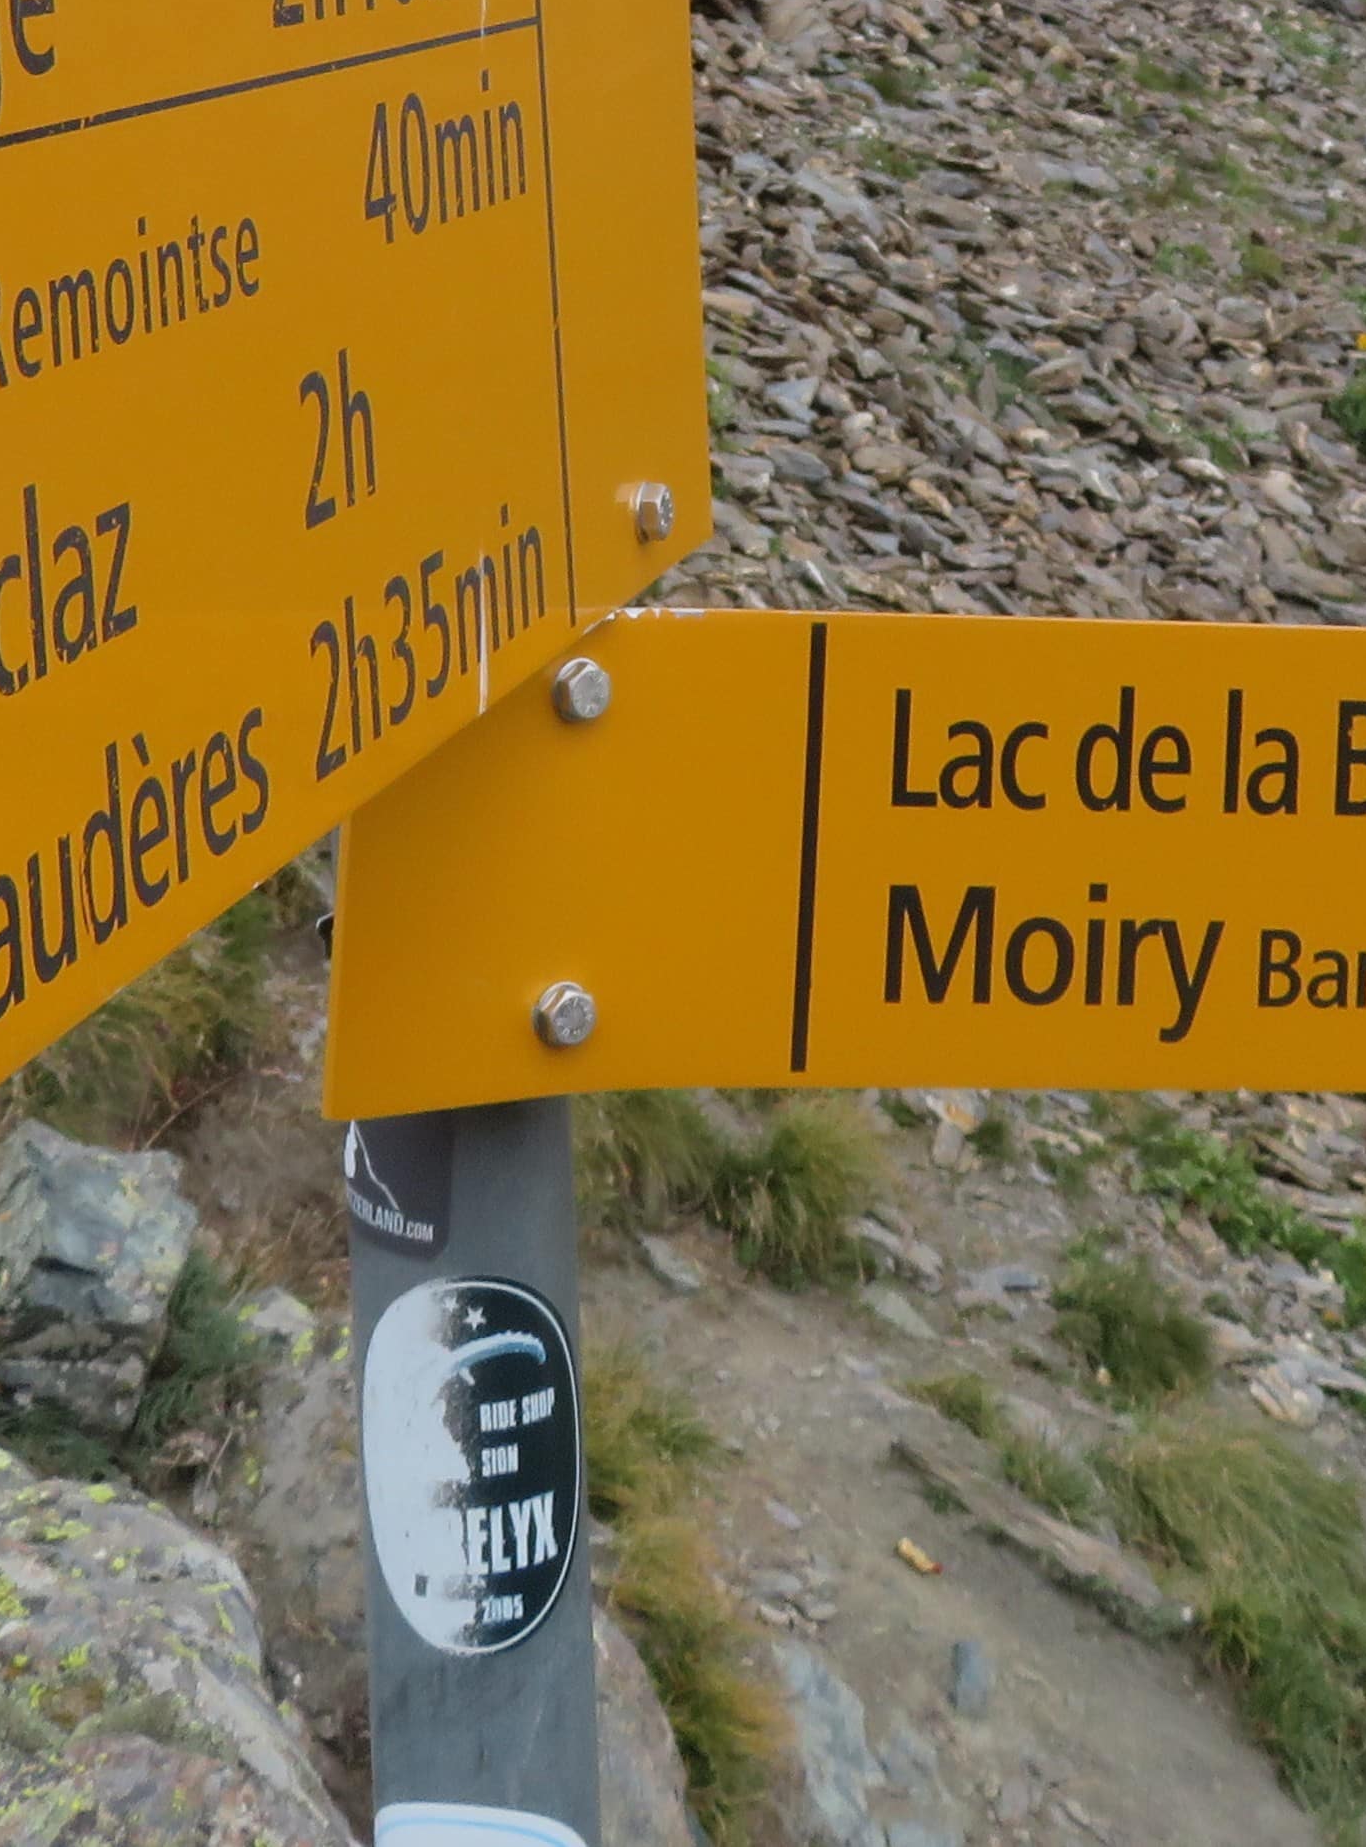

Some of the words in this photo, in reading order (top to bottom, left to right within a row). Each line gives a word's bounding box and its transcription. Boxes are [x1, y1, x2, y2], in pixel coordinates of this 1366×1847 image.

[364, 69, 528, 246] 40min
[301, 350, 375, 528] 2h
[310, 504, 548, 785] 2h35min
[892, 689, 1047, 810] Lac
[1076, 686, 1190, 812] de
[1224, 690, 1298, 814] la
[885, 884, 1223, 1042] Moiry
[480, 1397, 518, 1432] RIDE
[521, 1387, 555, 1425] SHOP
[482, 1443, 519, 1478] SION
